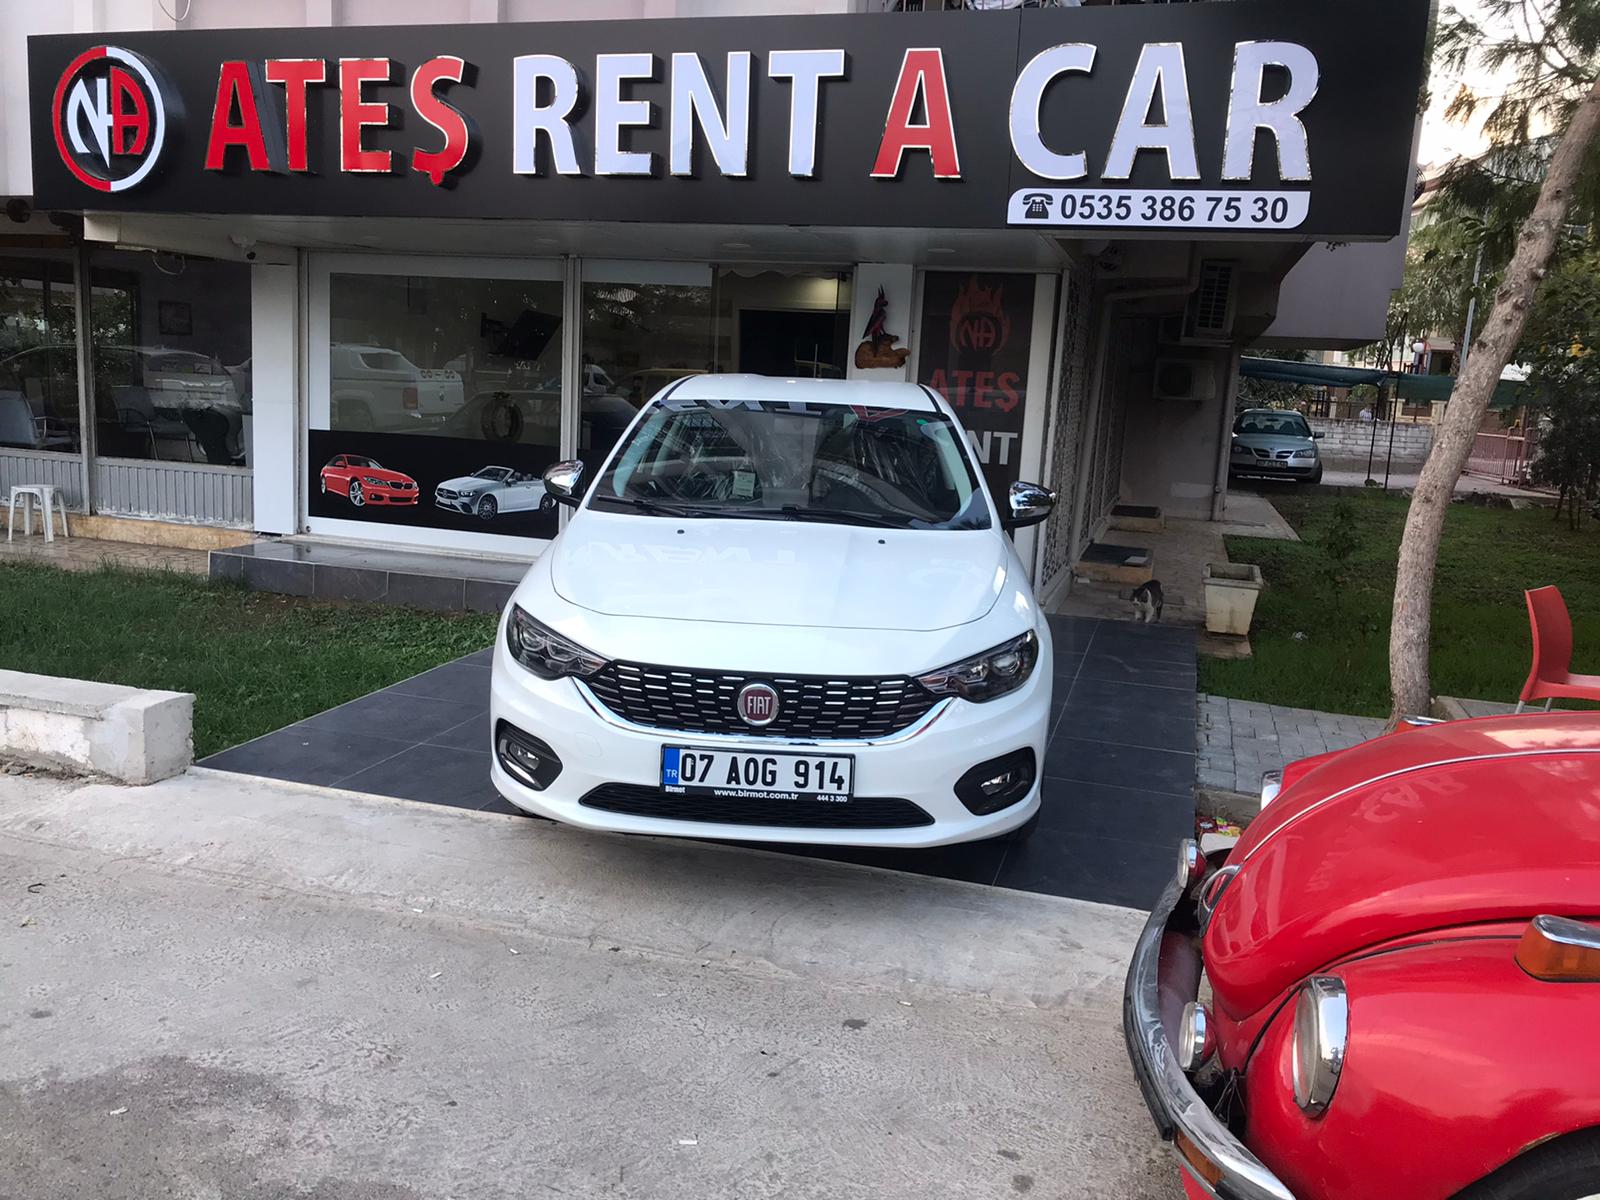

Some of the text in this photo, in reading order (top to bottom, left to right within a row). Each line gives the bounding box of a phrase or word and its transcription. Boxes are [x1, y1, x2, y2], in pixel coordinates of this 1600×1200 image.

[205, 41, 1320, 187] ATEŞ RENT A CAR
[1060, 193, 1289, 224] 0535 386 75 30
[930, 368, 1020, 413] ATEŞ
[966, 430, 1018, 465] NT
[746, 695, 771, 715] FIAT
[666, 769, 678, 778] TR
[681, 753, 845, 791] 07 AOG 914
[713, 789, 799, 800] www.birmot.com.tr
[816, 794, 829, 802] 444
